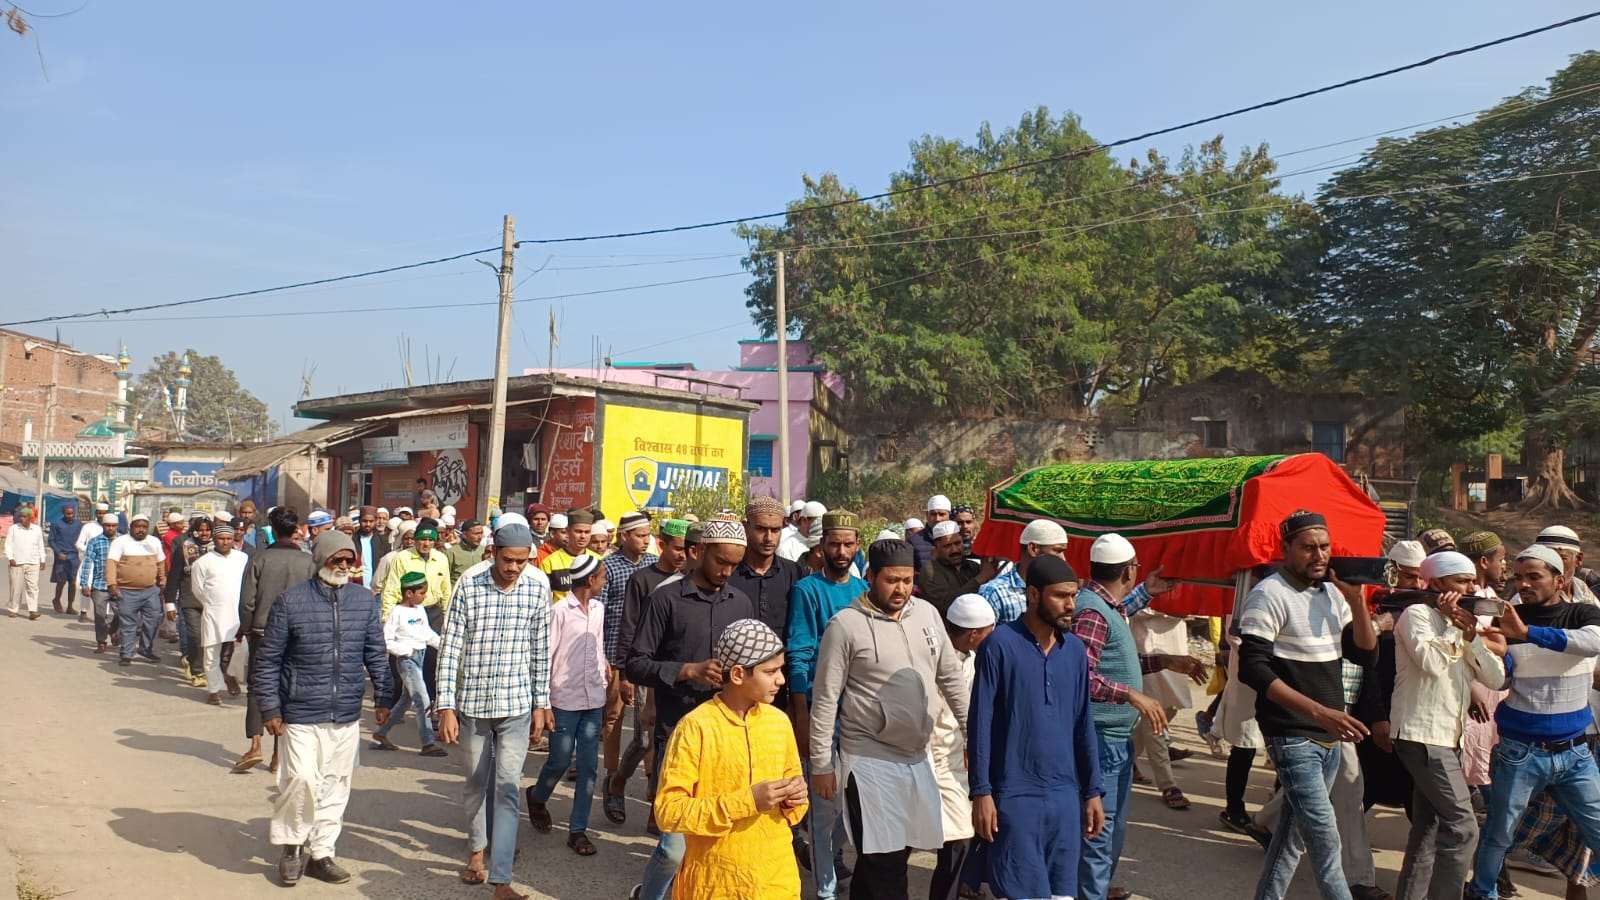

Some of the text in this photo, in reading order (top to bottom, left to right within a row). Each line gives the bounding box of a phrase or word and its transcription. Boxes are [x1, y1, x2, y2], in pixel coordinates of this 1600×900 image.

[634, 437, 673, 454] विश्वास
[676, 443, 687, 456] 48
[711, 447, 725, 458] का
